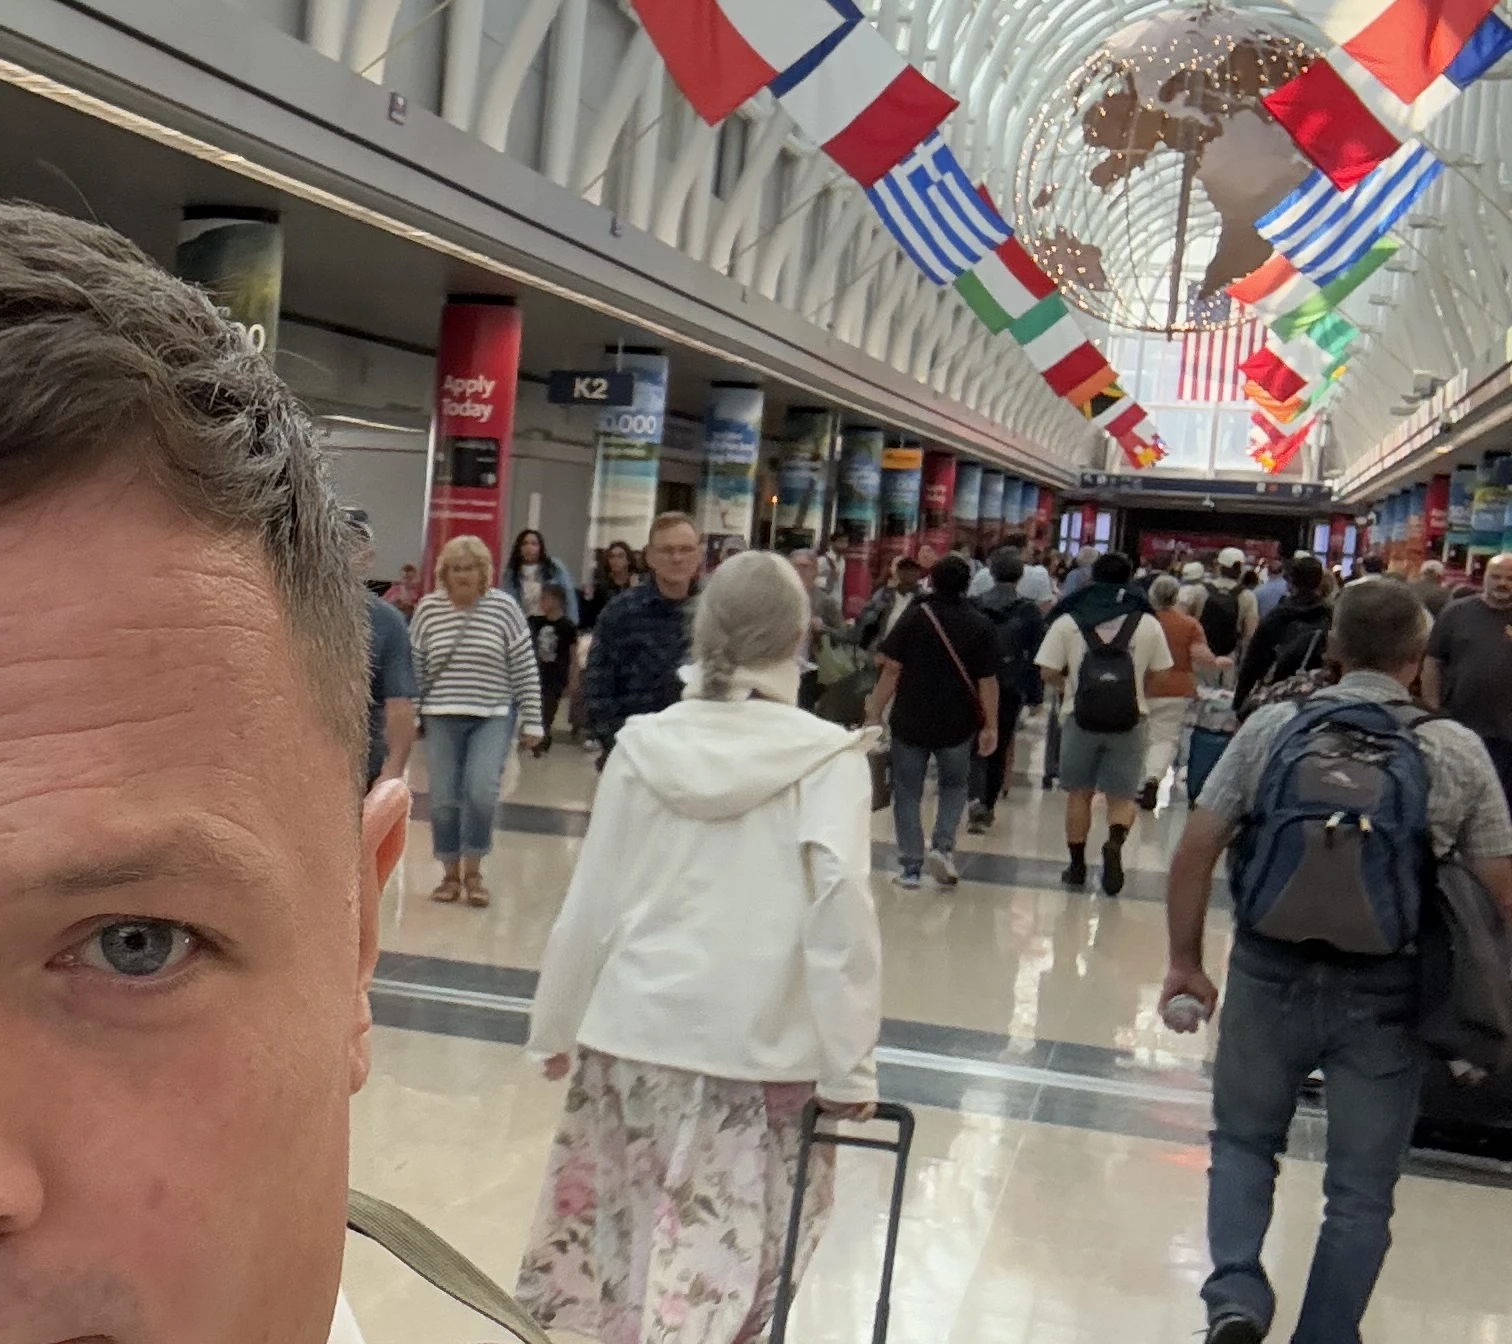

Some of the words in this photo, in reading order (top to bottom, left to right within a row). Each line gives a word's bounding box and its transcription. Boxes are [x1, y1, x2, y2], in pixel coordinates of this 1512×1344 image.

[443, 374, 496, 399] Apply
[573, 376, 609, 400] K2
[441, 398, 494, 424] Today
